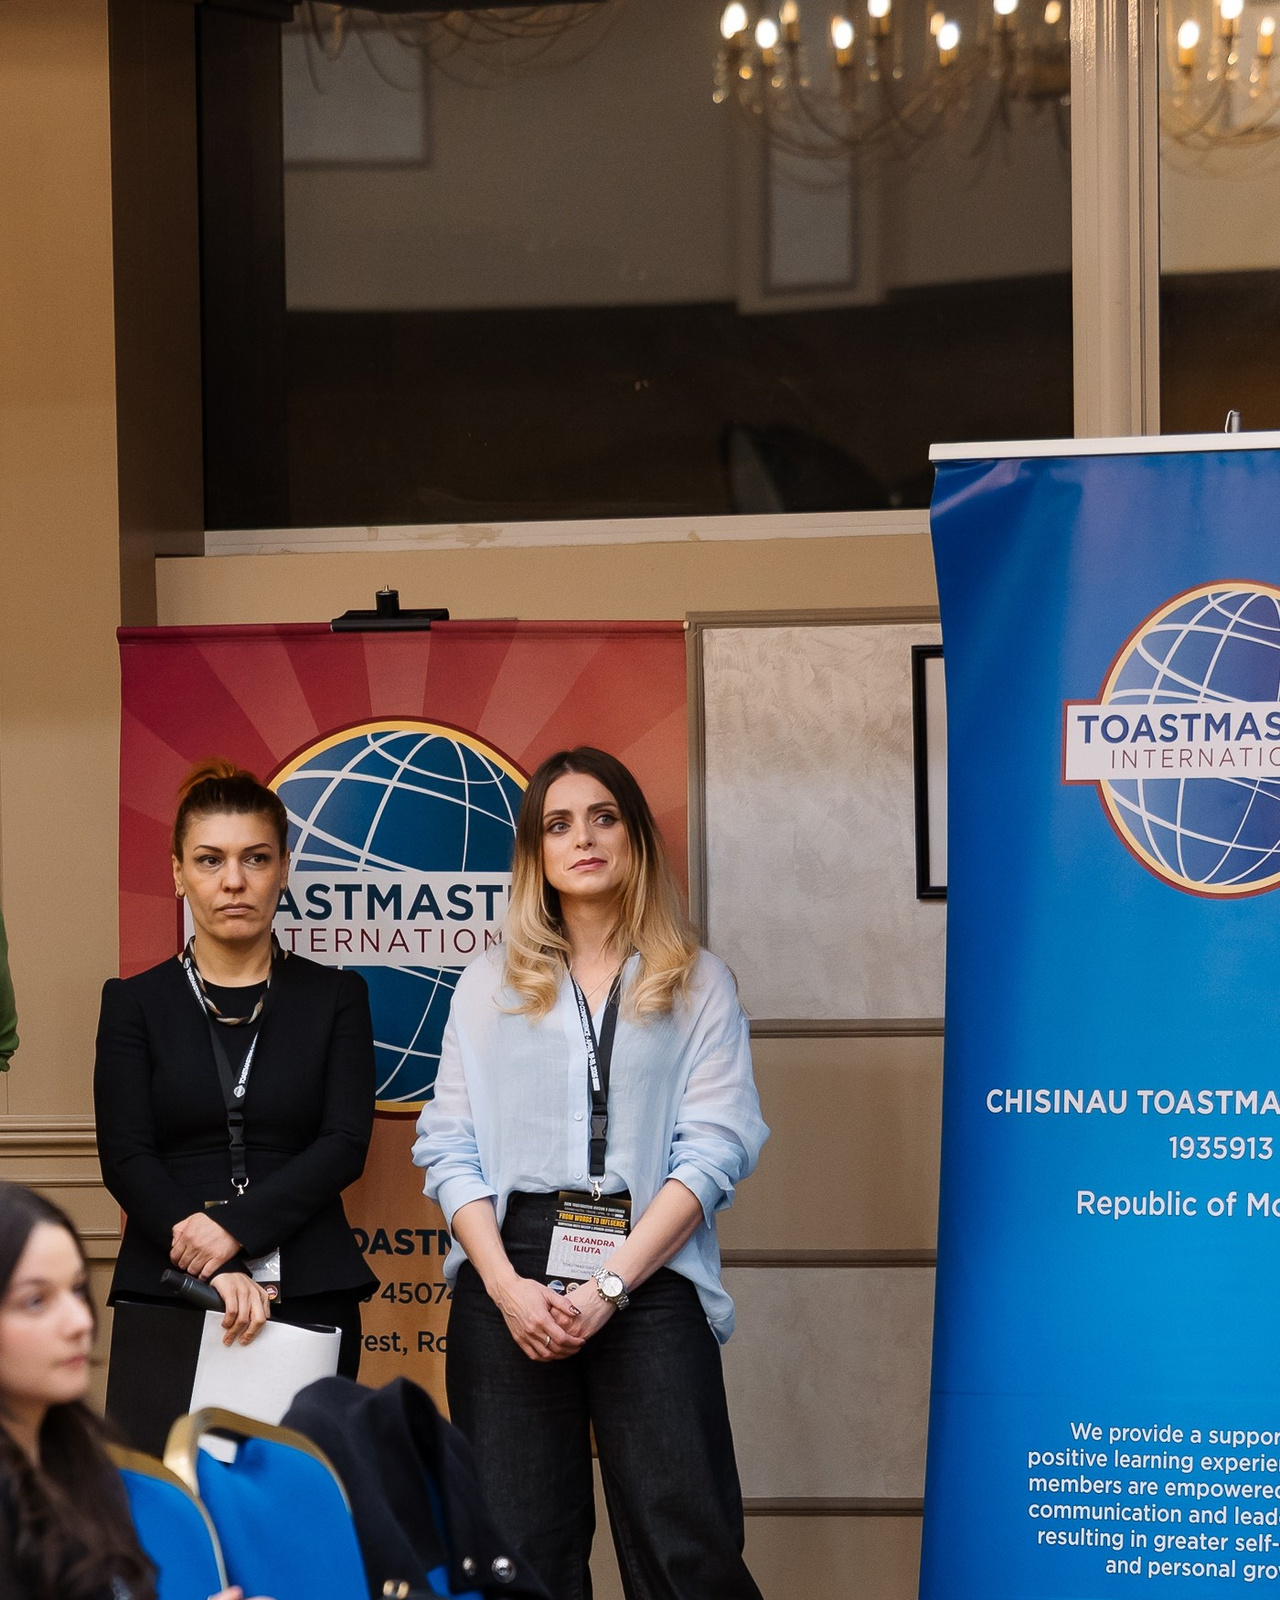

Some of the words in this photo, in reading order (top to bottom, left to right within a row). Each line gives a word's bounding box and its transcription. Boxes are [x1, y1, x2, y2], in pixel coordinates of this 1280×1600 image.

[1077, 712, 1280, 744] TOASTMAS
[986, 1089, 1127, 1114] CHISINAU
[1137, 1090, 1280, 1115] TOASTMA
[1169, 1136, 1273, 1160] 1935913
[1077, 1190, 1197, 1220] Republic
[1207, 1191, 1237, 1217] of
[562, 1234, 615, 1247] ALEXANDRA
[1070, 1422, 1103, 1441] We
[1109, 1424, 1184, 1445] provide
[1190, 1430, 1202, 1444] a
[1028, 1448, 1108, 1469] positive
[1114, 1450, 1194, 1473] learning
[1201, 1453, 1280, 1474] experie
[1028, 1475, 1122, 1495] members
[1128, 1480, 1158, 1496] are
[1028, 1503, 1182, 1523] communication
[1188, 1505, 1227, 1525] and
[1235, 1506, 1280, 1526] lead
[1037, 1528, 1124, 1551] resulting
[1130, 1530, 1147, 1548] in
[1154, 1532, 1229, 1552] greater
[1235, 1533, 1280, 1552] self-
[1105, 1556, 1142, 1575] and
[1148, 1559, 1236, 1578] personal
[1243, 1564, 1280, 1582] gro
